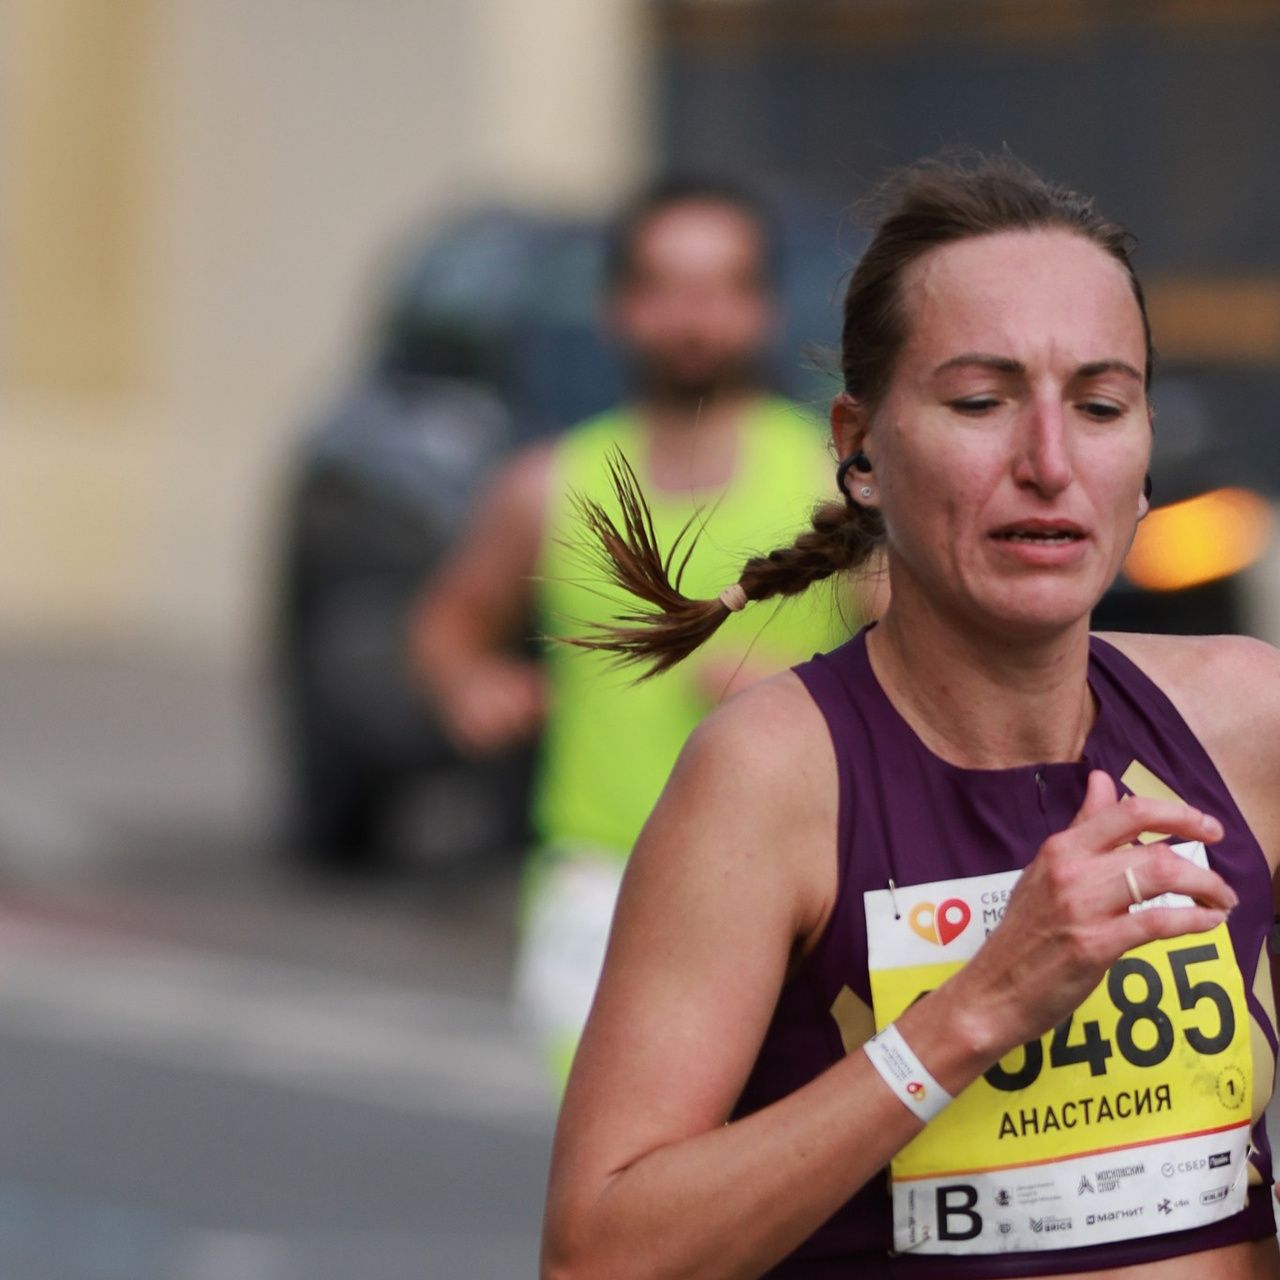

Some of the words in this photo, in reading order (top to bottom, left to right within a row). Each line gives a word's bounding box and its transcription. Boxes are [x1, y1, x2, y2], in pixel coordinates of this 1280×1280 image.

[908, 942, 1236, 1093] 485
[998, 1083, 1172, 1140] АНАСТАСИЯ
[1177, 1159, 1206, 1174] СБЕР
